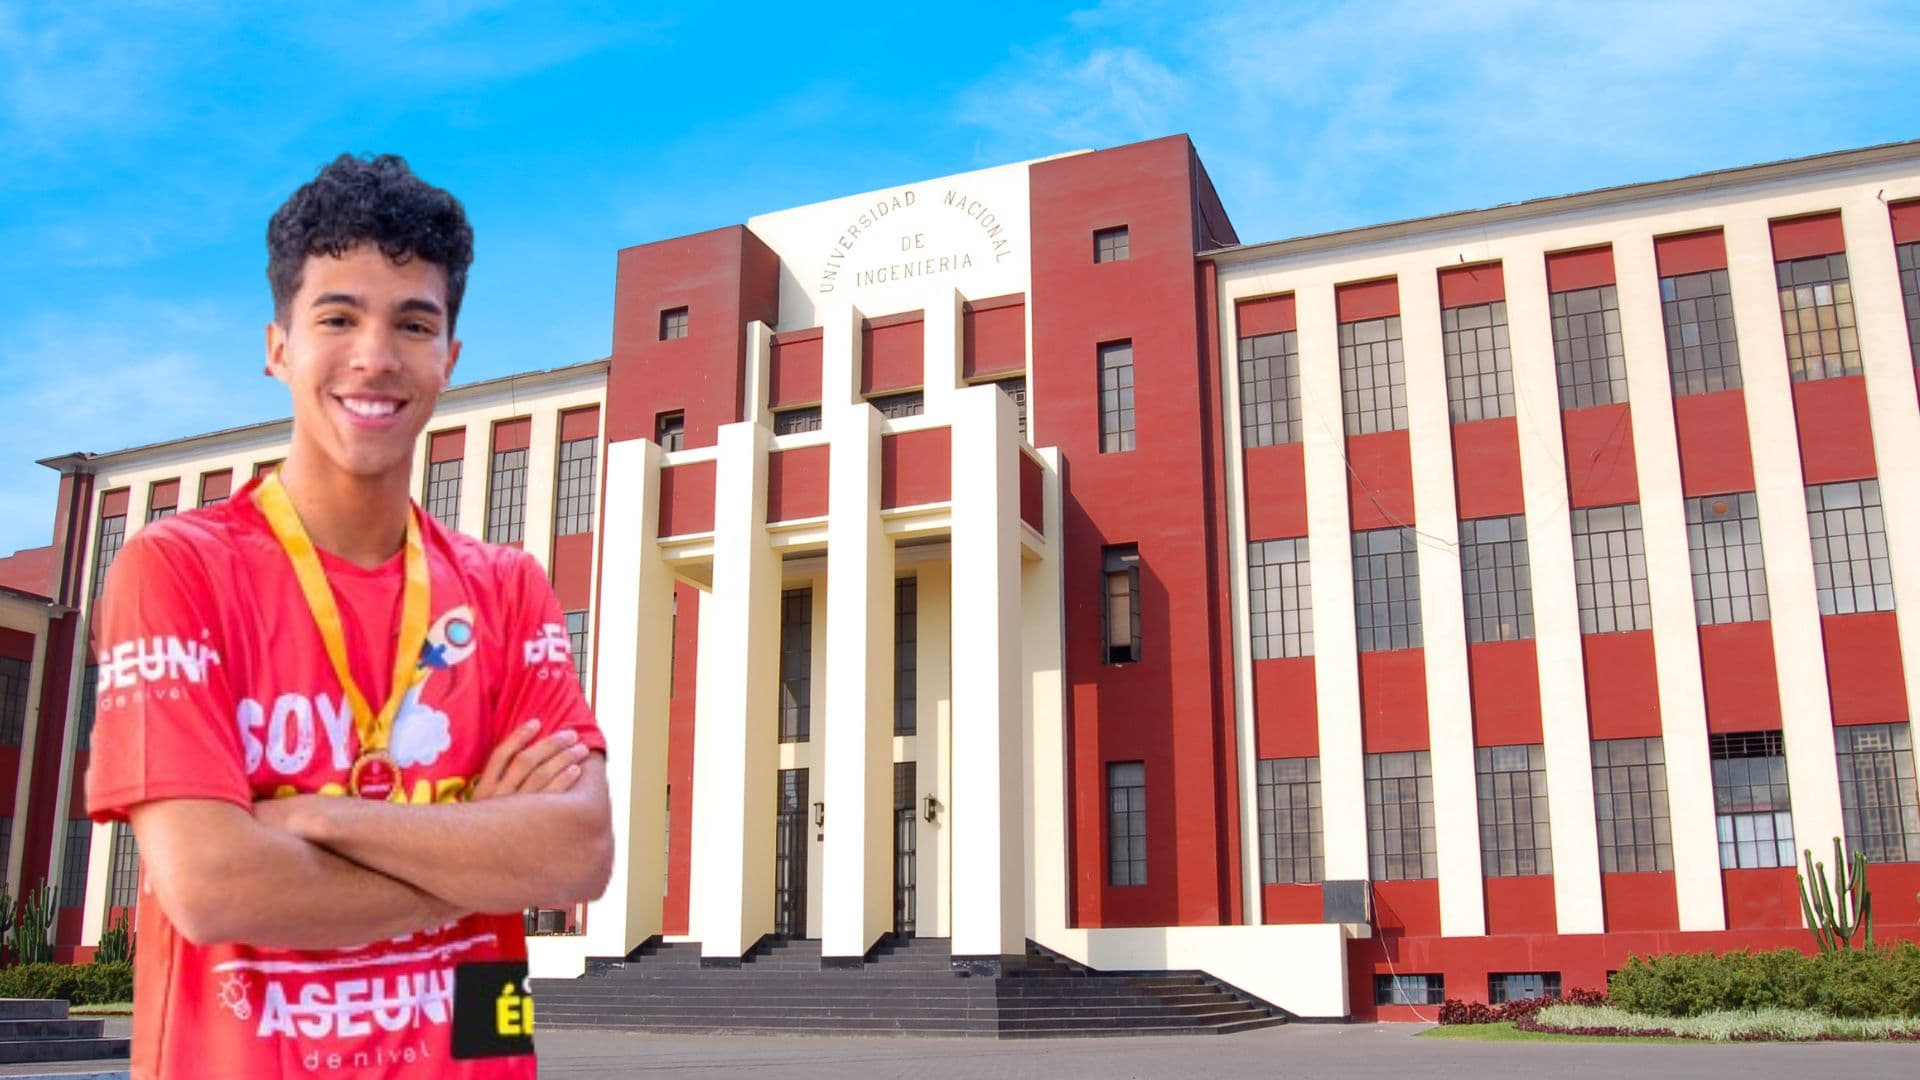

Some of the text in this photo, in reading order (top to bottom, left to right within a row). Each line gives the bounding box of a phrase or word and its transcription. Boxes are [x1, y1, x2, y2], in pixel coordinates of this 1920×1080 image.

[820, 189, 1012, 293] UNIVERSIDAD NACIONAL
[856, 252, 973, 287] INGENIERIA
[901, 233, 925, 251] DE
[236, 693, 352, 775] SOY
